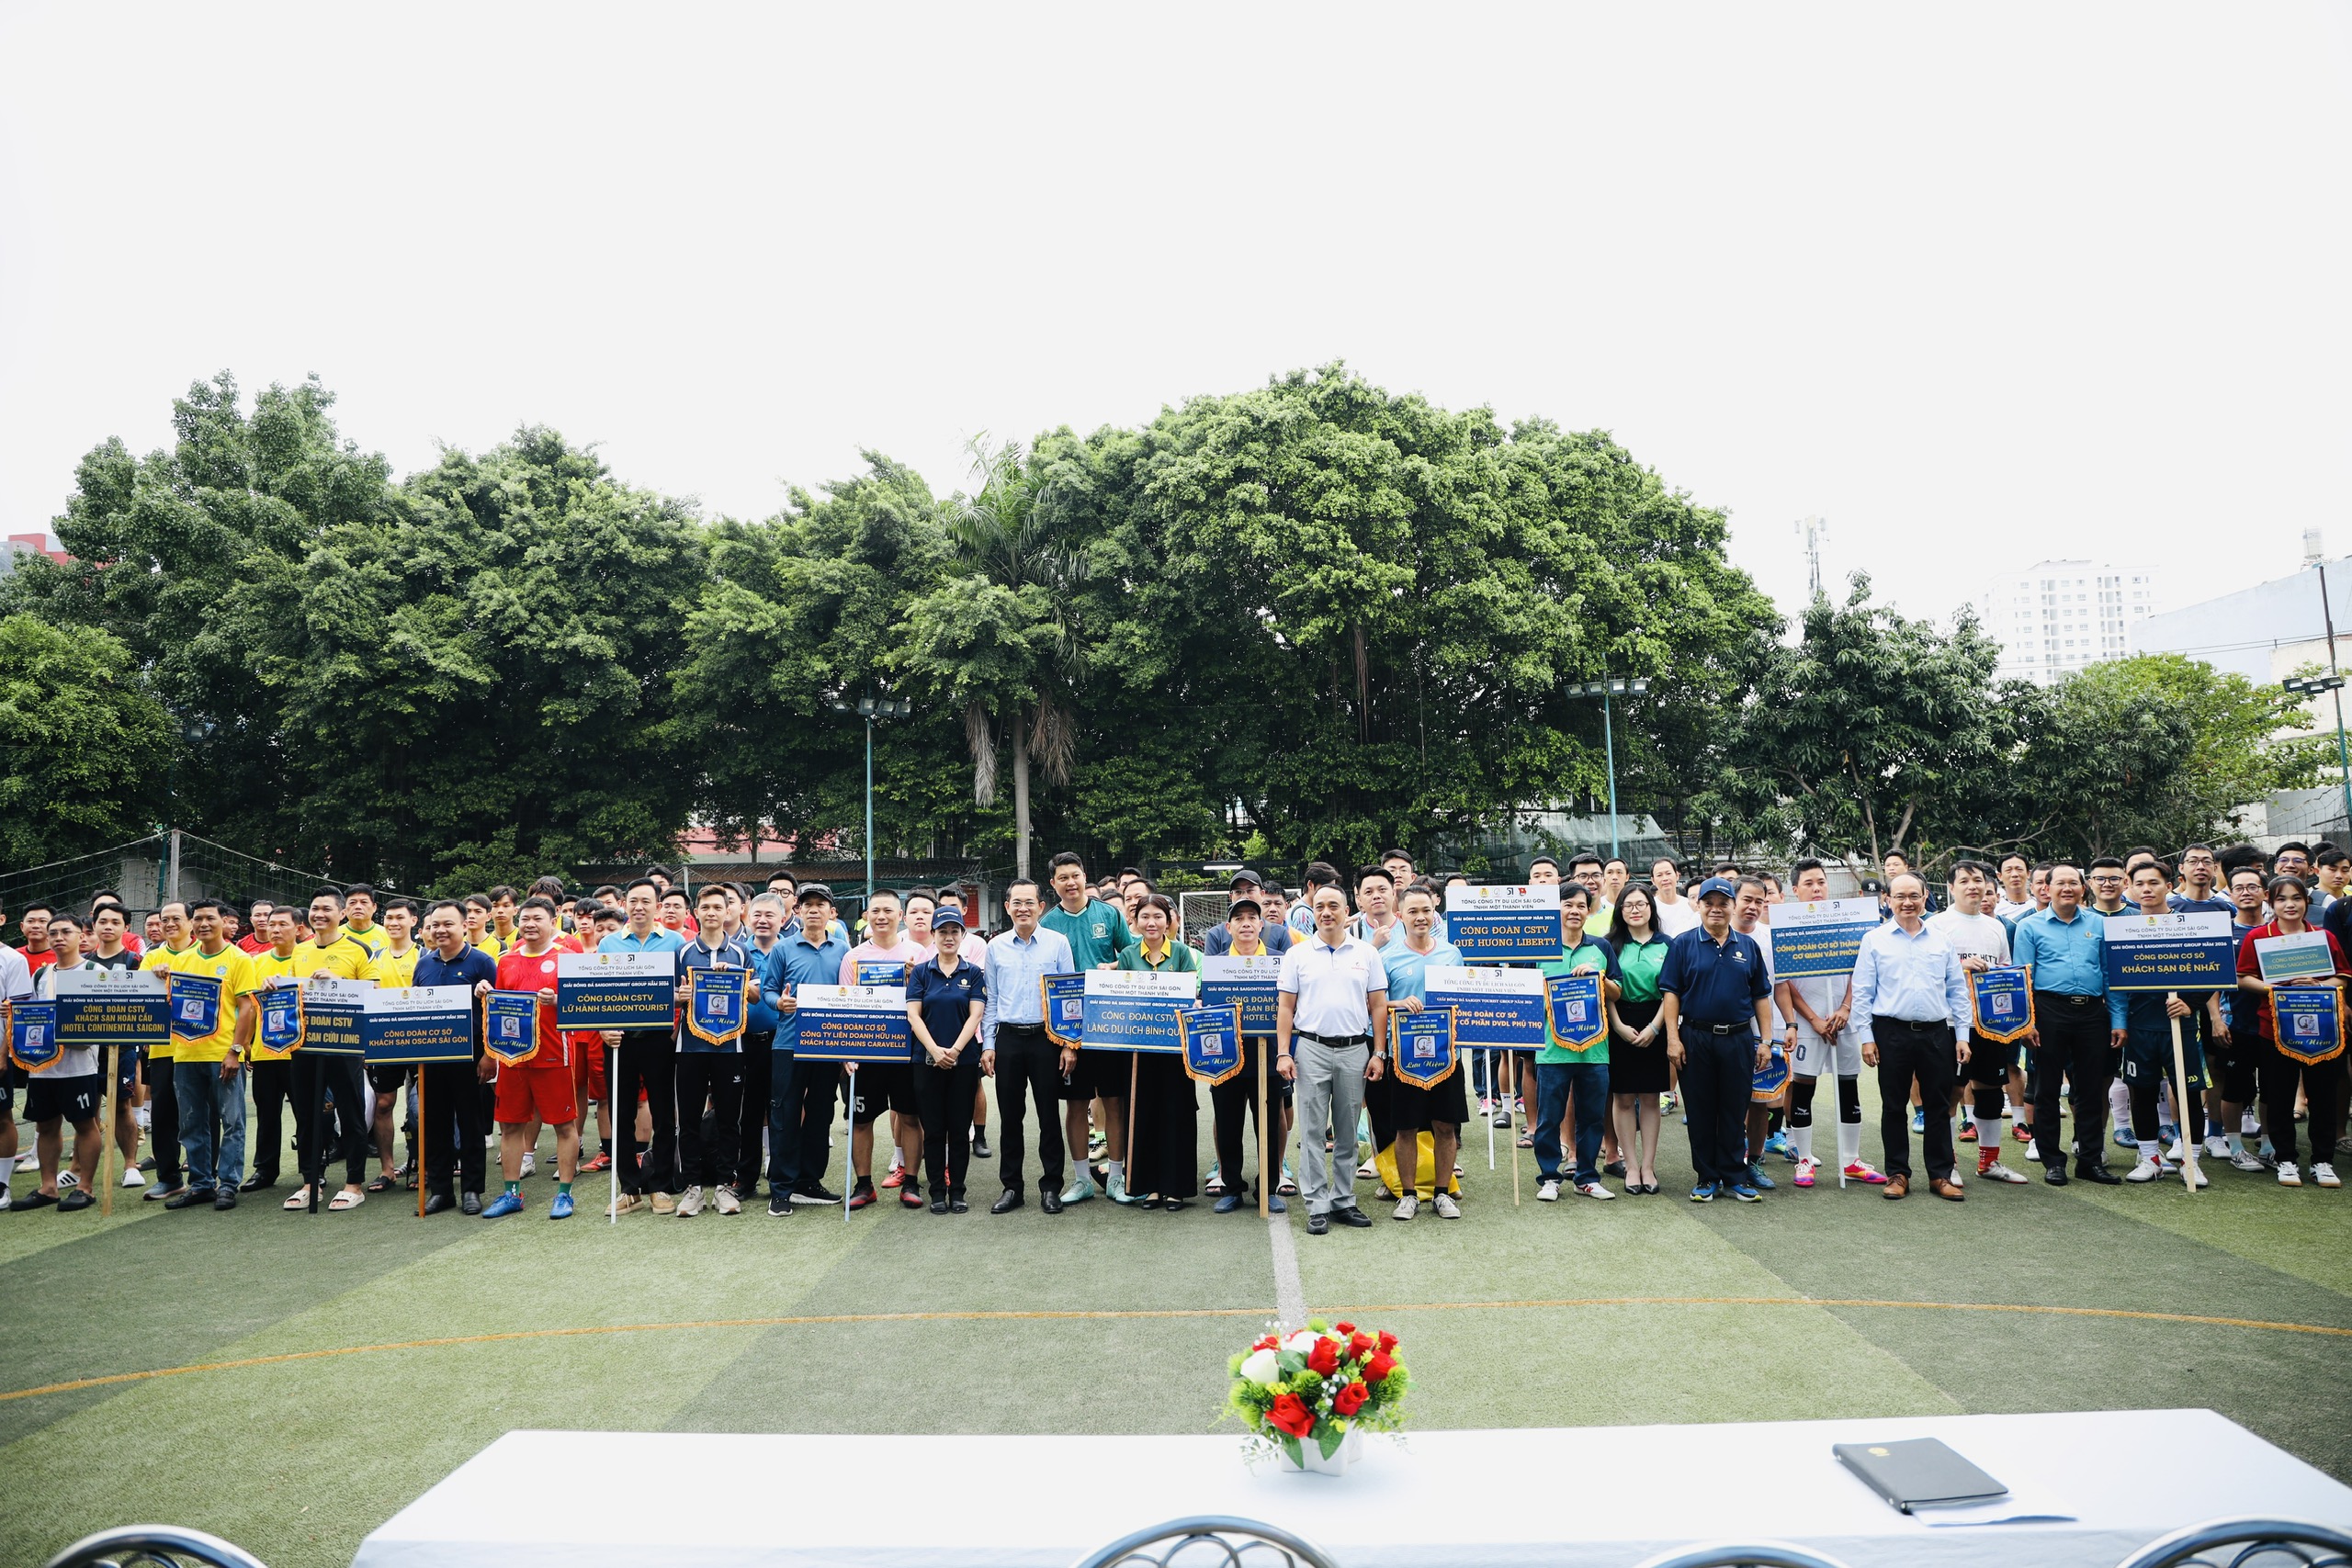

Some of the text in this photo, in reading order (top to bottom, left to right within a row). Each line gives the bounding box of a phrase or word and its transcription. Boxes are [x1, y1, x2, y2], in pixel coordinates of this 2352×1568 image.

[1460, 926, 1488, 935] CÔNG
[1492, 925, 1520, 934] ĐOÀN
[1454, 938, 1474, 947] QUÊ
[1776, 944, 1796, 952] CÔNG
[1797, 942, 1817, 951] ĐOÀN
[2122, 961, 2220, 974] KHÁCH SẠN ĐỆ NHẤT
[2288, 958, 2329, 968] SAIGONTOURIST
[577, 994, 602, 1002] CÔNG
[605, 993, 628, 1001] ĐOÀN
[562, 1004, 575, 1013] LỮ
[101, 1015, 115, 1023] SẠN
[138, 1013, 152, 1022] CẦU
[311, 1015, 331, 1025] ĐOÀN
[333, 1017, 353, 1027] CSTV
[1101, 1011, 1125, 1020] CÔNG
[1129, 1012, 1152, 1021] ĐOÀN
[61, 1024, 85, 1032] (HOTEL
[88, 1024, 134, 1032] CONTINENTAL
[137, 1024, 165, 1032] SAIGON)
[1087, 1024, 1108, 1032] LÀNG
[1125, 1026, 1143, 1035] LỊCH
[306, 1033, 321, 1043] SẠN
[341, 1034, 359, 1044] LONG
[77, 1093, 90, 1109] 11
